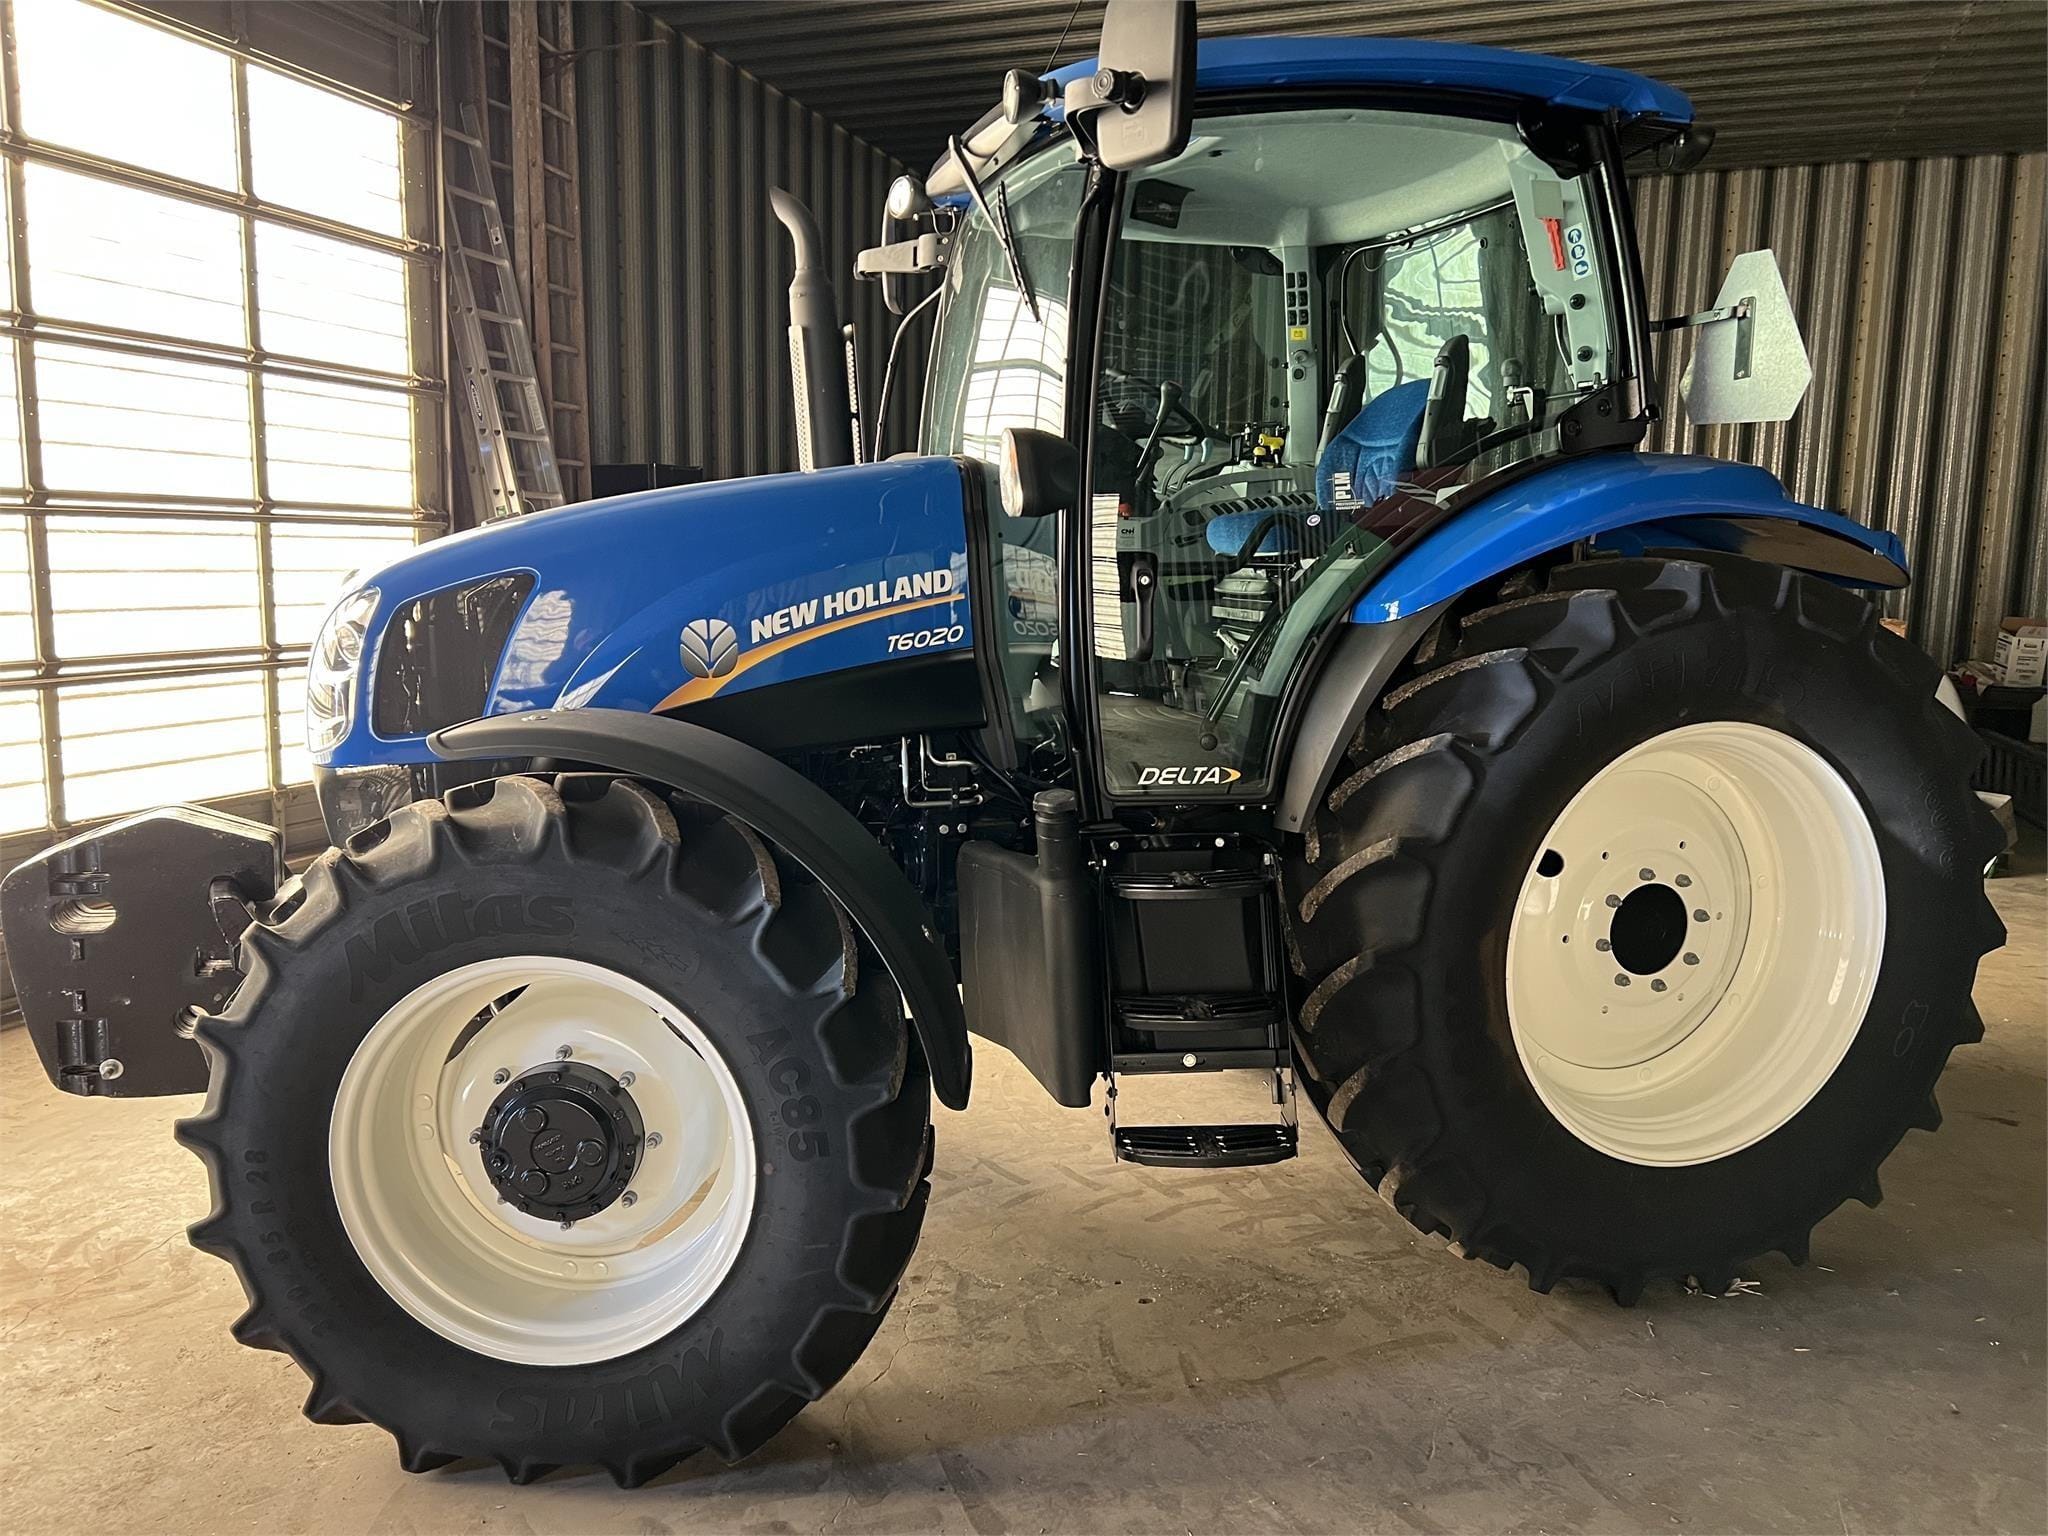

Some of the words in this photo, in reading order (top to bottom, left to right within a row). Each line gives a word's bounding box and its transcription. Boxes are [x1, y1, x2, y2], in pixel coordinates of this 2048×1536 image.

[1334, 472, 1351, 500] PLM
[751, 599, 819, 644] NEW
[823, 569, 953, 620] HOLLAND
[887, 625, 964, 653] T6020
[1138, 766, 1220, 785] DELTA
[344, 891, 577, 1004] Mitas
[489, 1327, 723, 1436] Mitas
